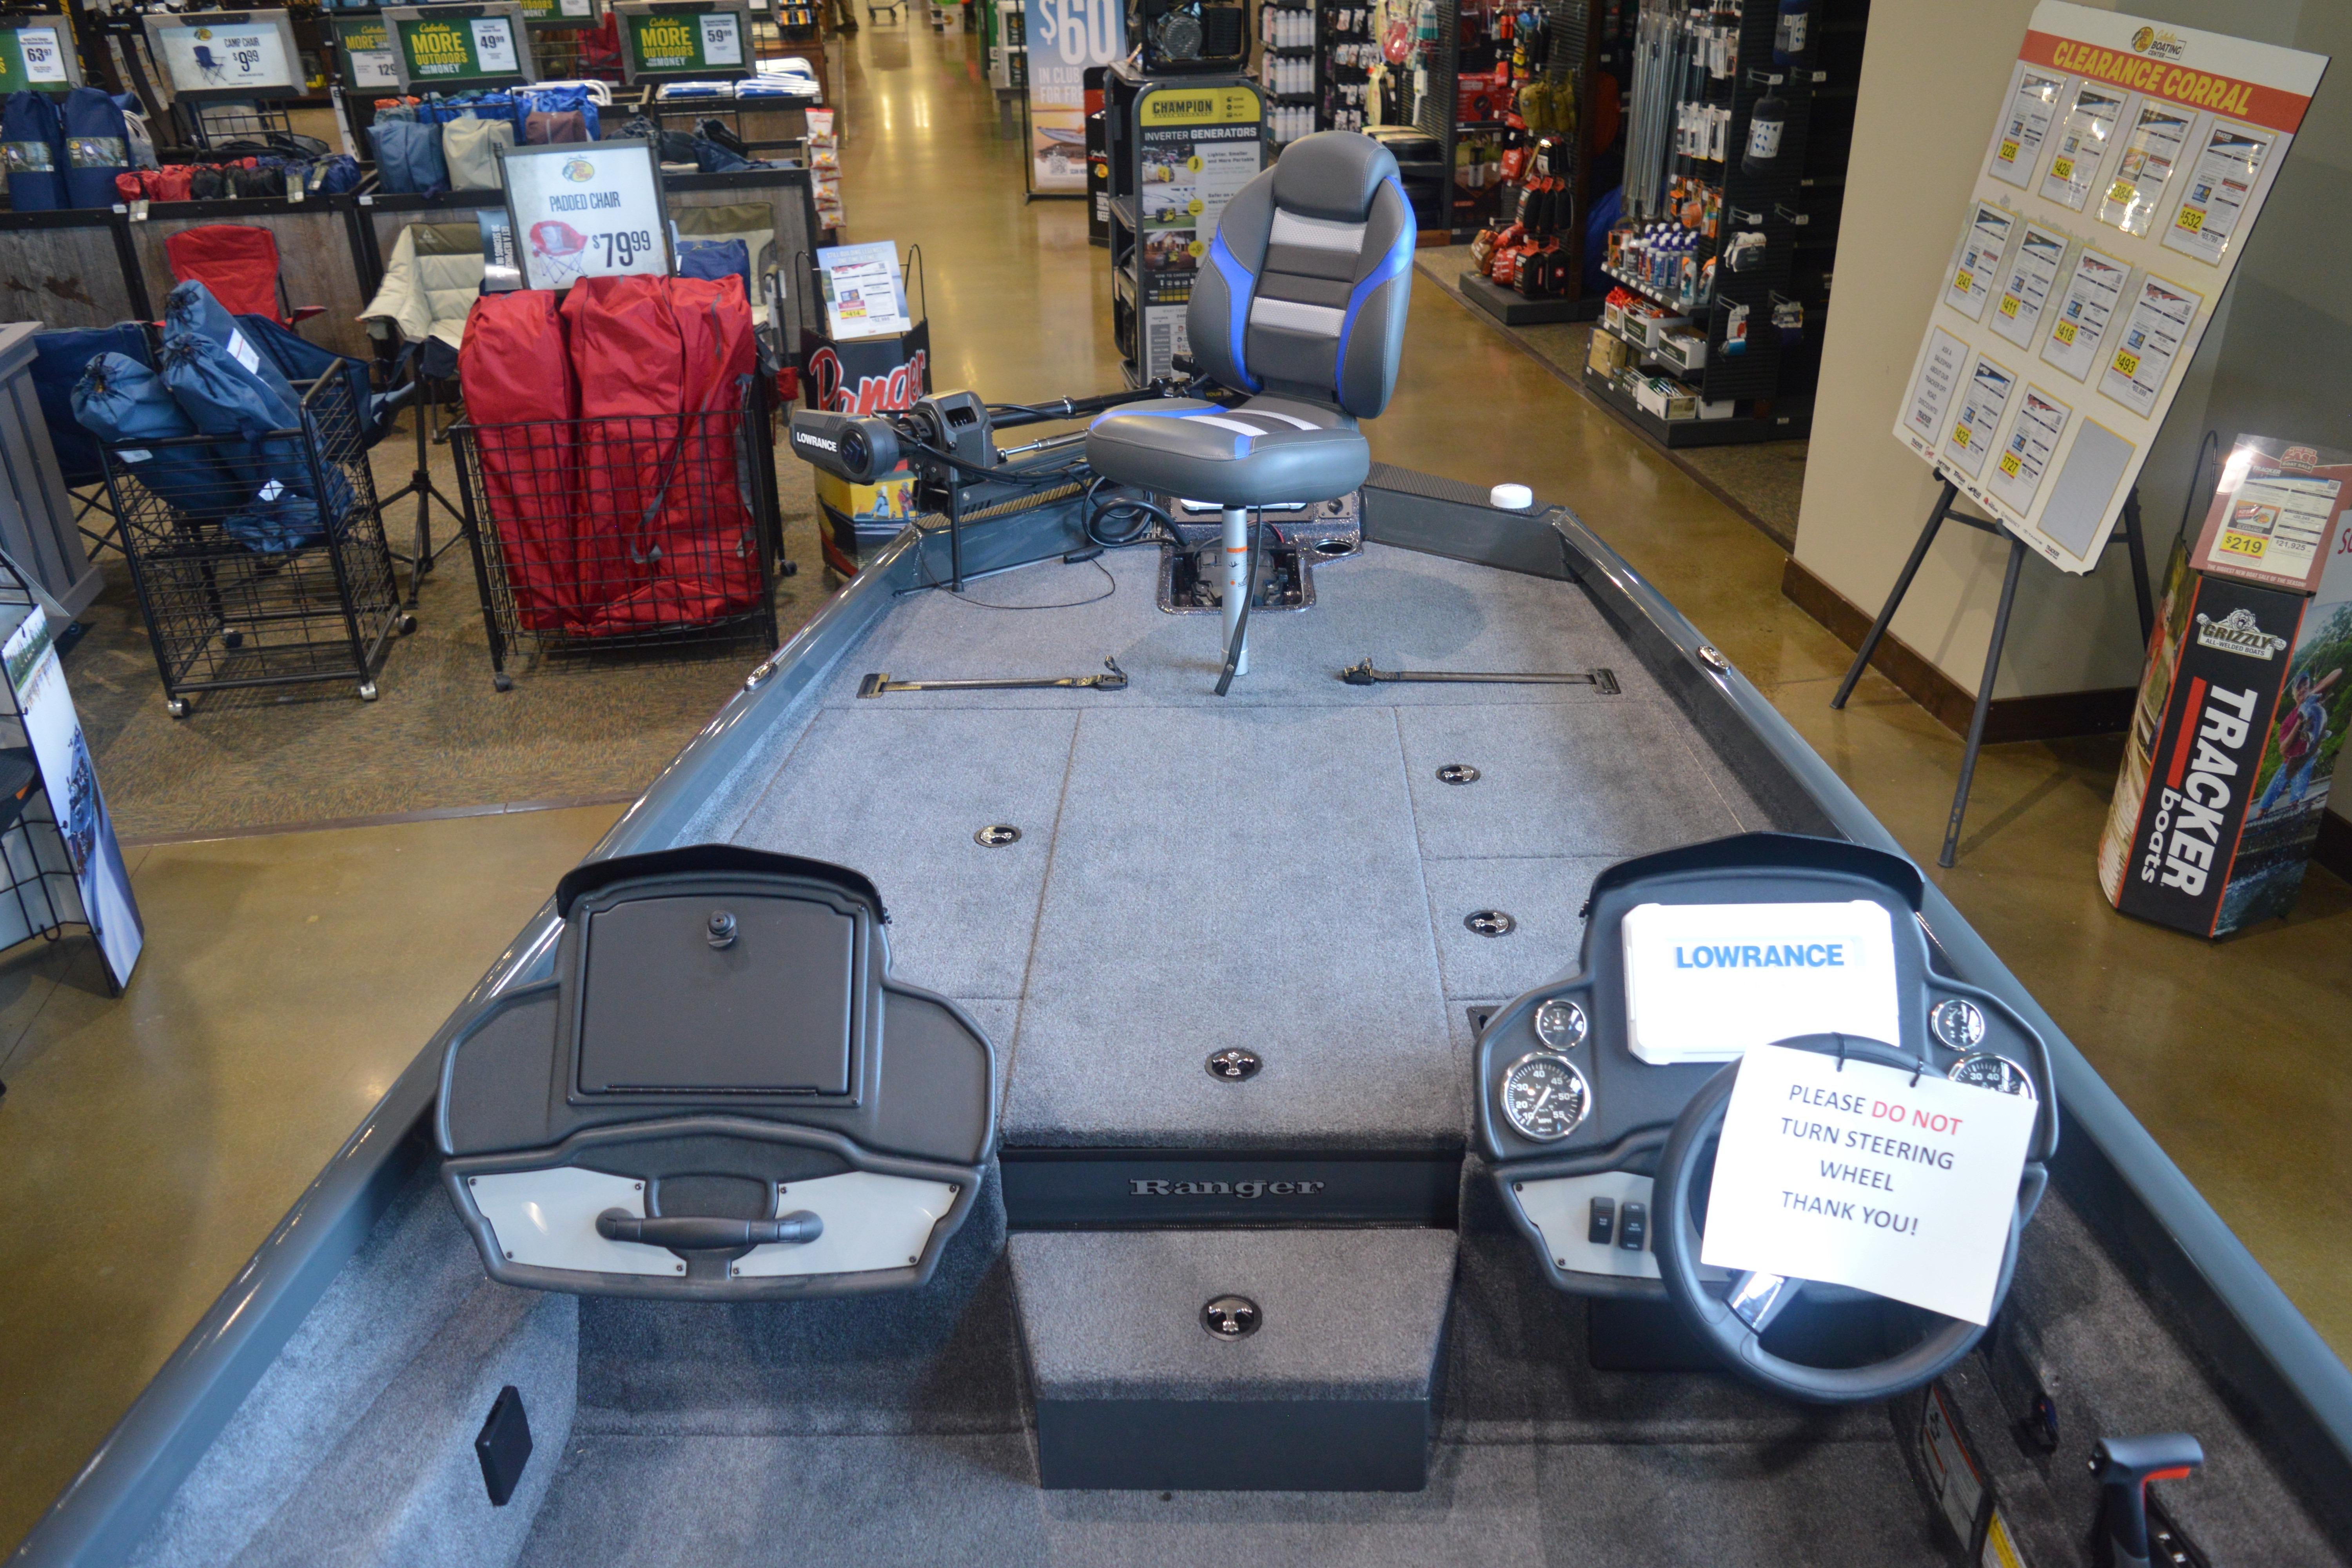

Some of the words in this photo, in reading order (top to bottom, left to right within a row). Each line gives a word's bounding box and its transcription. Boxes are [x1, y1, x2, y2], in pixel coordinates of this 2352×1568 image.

[224, 38, 241, 48] CAMP
[242, 37, 260, 47] CHAIR
[345, 35, 376, 50] MORE
[411, 32, 465, 53] MORE
[640, 27, 693, 47] MORE
[643, 45, 695, 58] OUTDOORS
[2148, 50, 2165, 58] CENTER
[2151, 41, 2182, 55] BOATING
[415, 52, 468, 65] OUTDOORS
[656, 56, 687, 66] MONEY
[430, 64, 461, 73] MONEY
[1038, 67, 1050, 83] IN
[1053, 67, 1080, 83] CLUB
[2053, 41, 2166, 91] CLEARANCE
[2163, 69, 2253, 116] CORRAL
[1040, 86, 1061, 103] FOR
[1153, 100, 1212, 114] CHAMPION
[1145, 131, 1189, 141] INVERTER
[1191, 127, 1257, 139] GENERATORS
[2002, 143, 2016, 159] $228
[2054, 161, 2071, 177] $428
[550, 194, 588, 212] PADDED
[589, 191, 621, 209] CHAIR
[2180, 211, 2202, 229] $532
[492, 232, 504, 256] SECONDS
[1957, 273, 1971, 290] $243
[2002, 298, 2018, 312] $411
[2058, 324, 2074, 341] $418
[1934, 354, 1952, 370] SALESMAN
[2117, 354, 2136, 374] $493
[1926, 374, 1940, 389] TRACKER
[1930, 365, 1941, 377] ABOUT
[1941, 373, 1949, 381] OUR
[809, 347, 926, 418] Ranger
[1927, 390, 1937, 401] ROAD
[1917, 409, 1932, 424] TRACKER
[796, 432, 838, 452] LOWRANCE
[1955, 428, 1969, 445] $422
[2003, 456, 2018, 473] $727
[2252, 465, 2282, 475] TRACKER
[2046, 544, 2060, 557] TRACKER
[2226, 535, 2263, 554] $219
[2276, 539, 2306, 551] $21,925
[2216, 565, 2235, 574] BIGGEST
[2202, 624, 2273, 650] GRIZZLY
[2205, 638, 2244, 652] ALL-WELDED
[2245, 647, 2265, 656] BOATS
[2161, 685, 2258, 896] TRACKER
[2141, 787, 2181, 884] boats
[1676, 944, 1845, 969] LOWRANCE
[1553, 1111, 1565, 1119] 55
[1789, 1083, 1866, 1115] PLEASE
[1871, 1100, 1906, 1124] DO
[1912, 1110, 1963, 1136] NOT
[1780, 1116, 1840, 1145] TURN
[1845, 1130, 1953, 1170] STEERING
[1820, 1159, 1895, 1193] WHEEL
[1128, 1177, 1327, 1199] Ranger
[1781, 1189, 1854, 1221] THANK
[1862, 1207, 1919, 1238] YOU!
